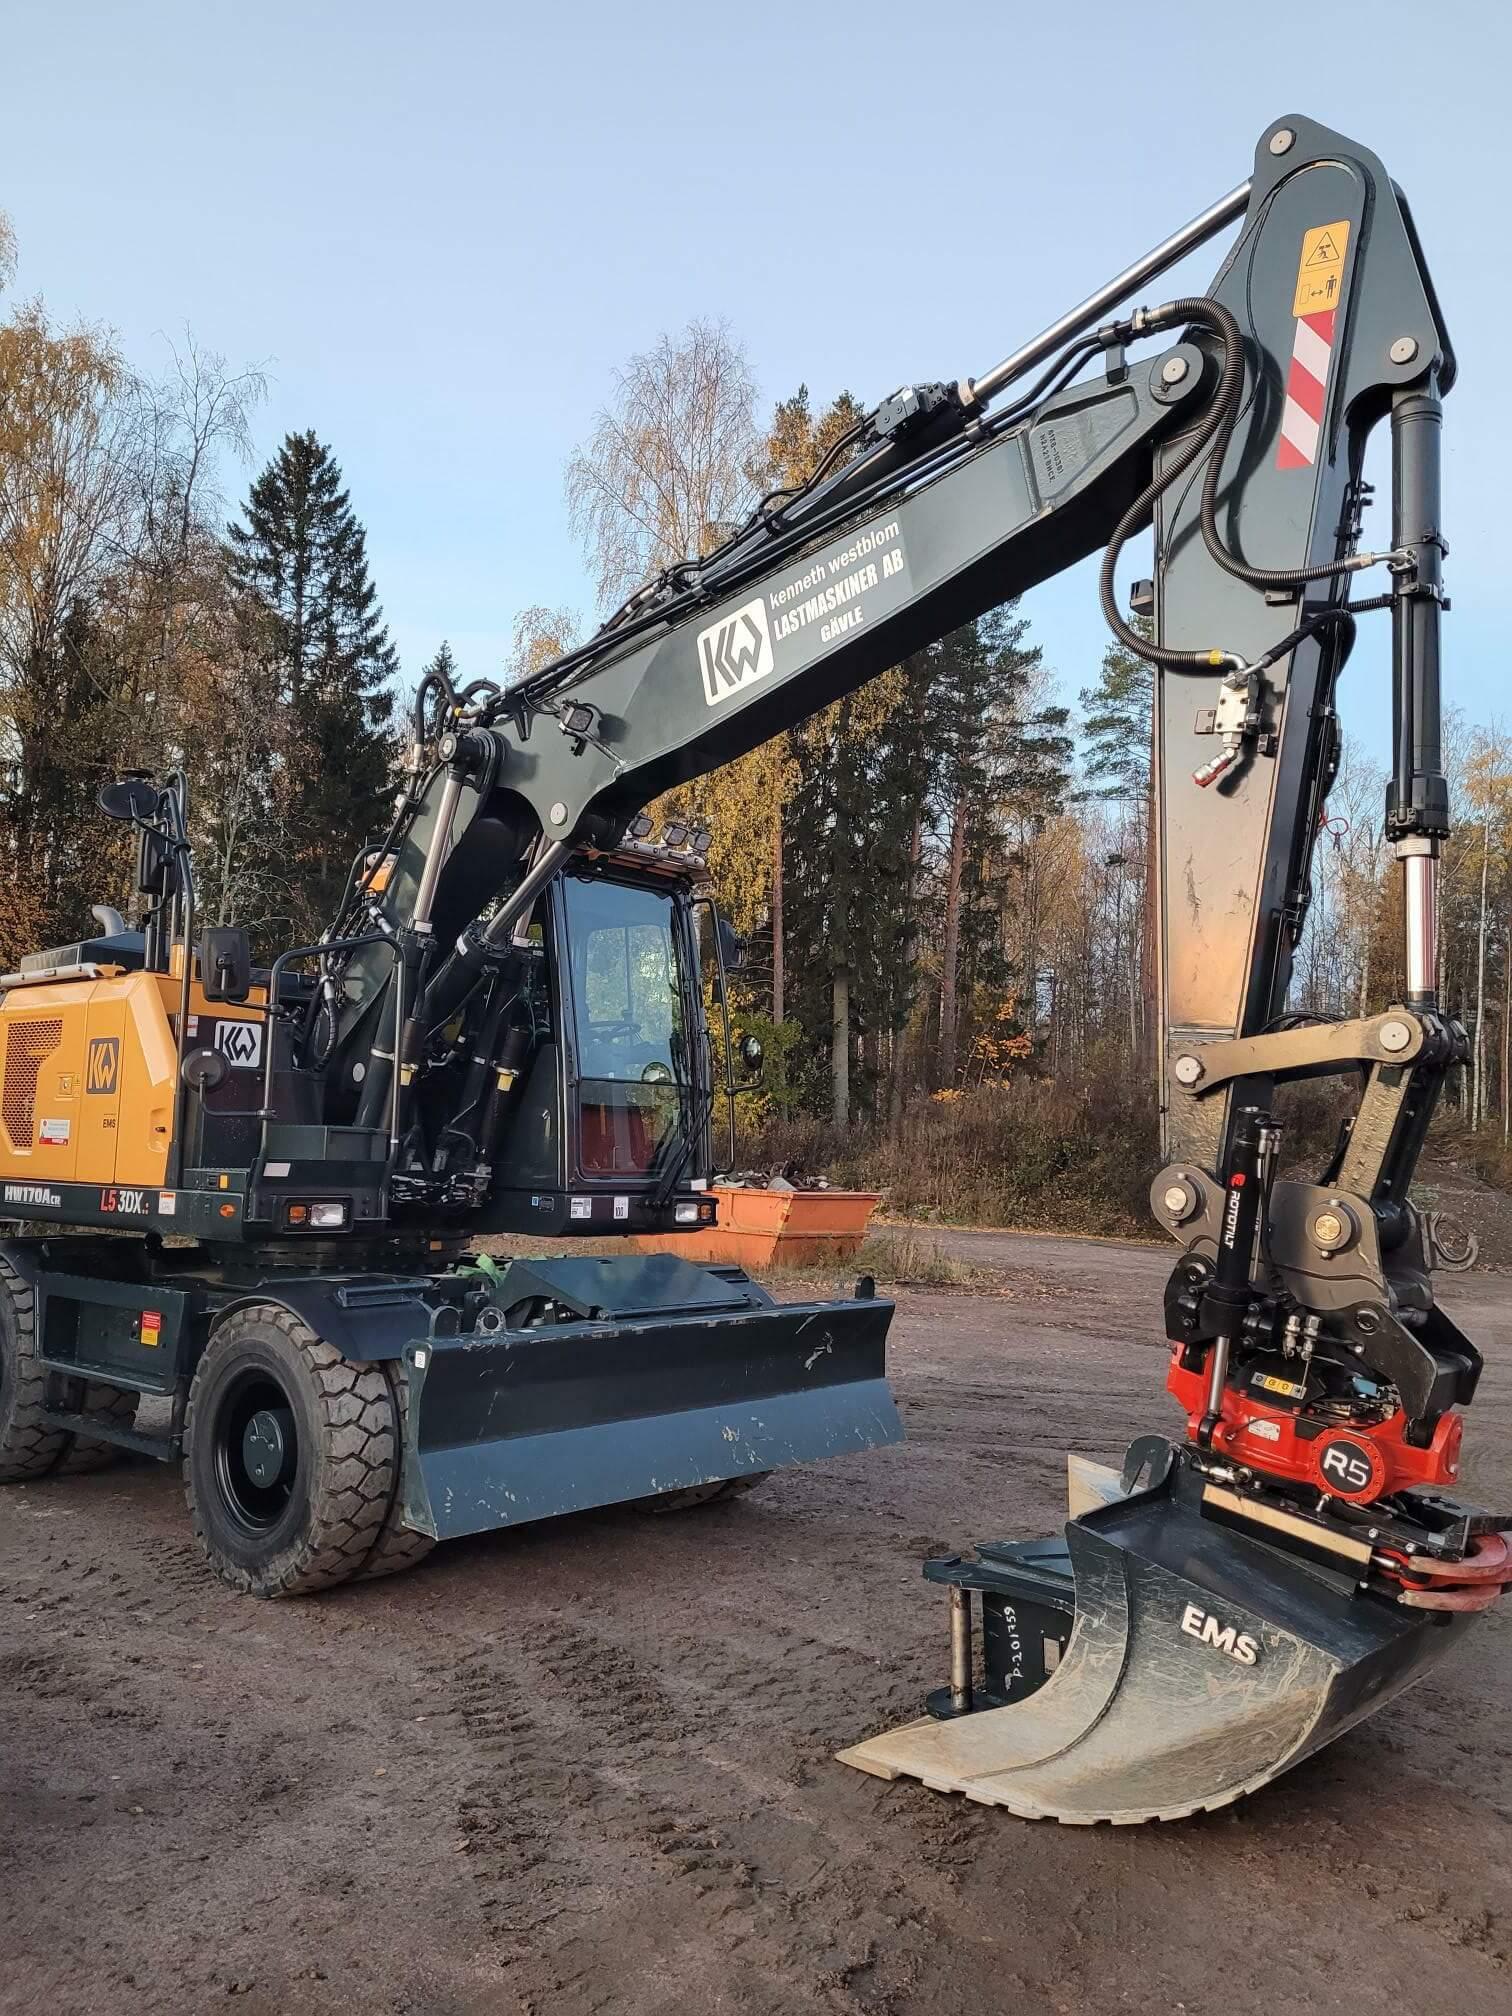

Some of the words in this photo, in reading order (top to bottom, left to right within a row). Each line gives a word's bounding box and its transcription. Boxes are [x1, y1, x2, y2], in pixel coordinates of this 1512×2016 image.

[769, 564, 826, 610] kenneth
[828, 521, 900, 574] westblom
[773, 563, 879, 641] LASTMASKINER
[882, 548, 904, 579] AB
[820, 605, 864, 642] GÄVLE
[102, 1118, 116, 1129] EMS
[1224, 1190, 1241, 1250] ROTOTILT
[1323, 1448, 1369, 1486] R5
[1181, 1601, 1259, 1666] EMS
